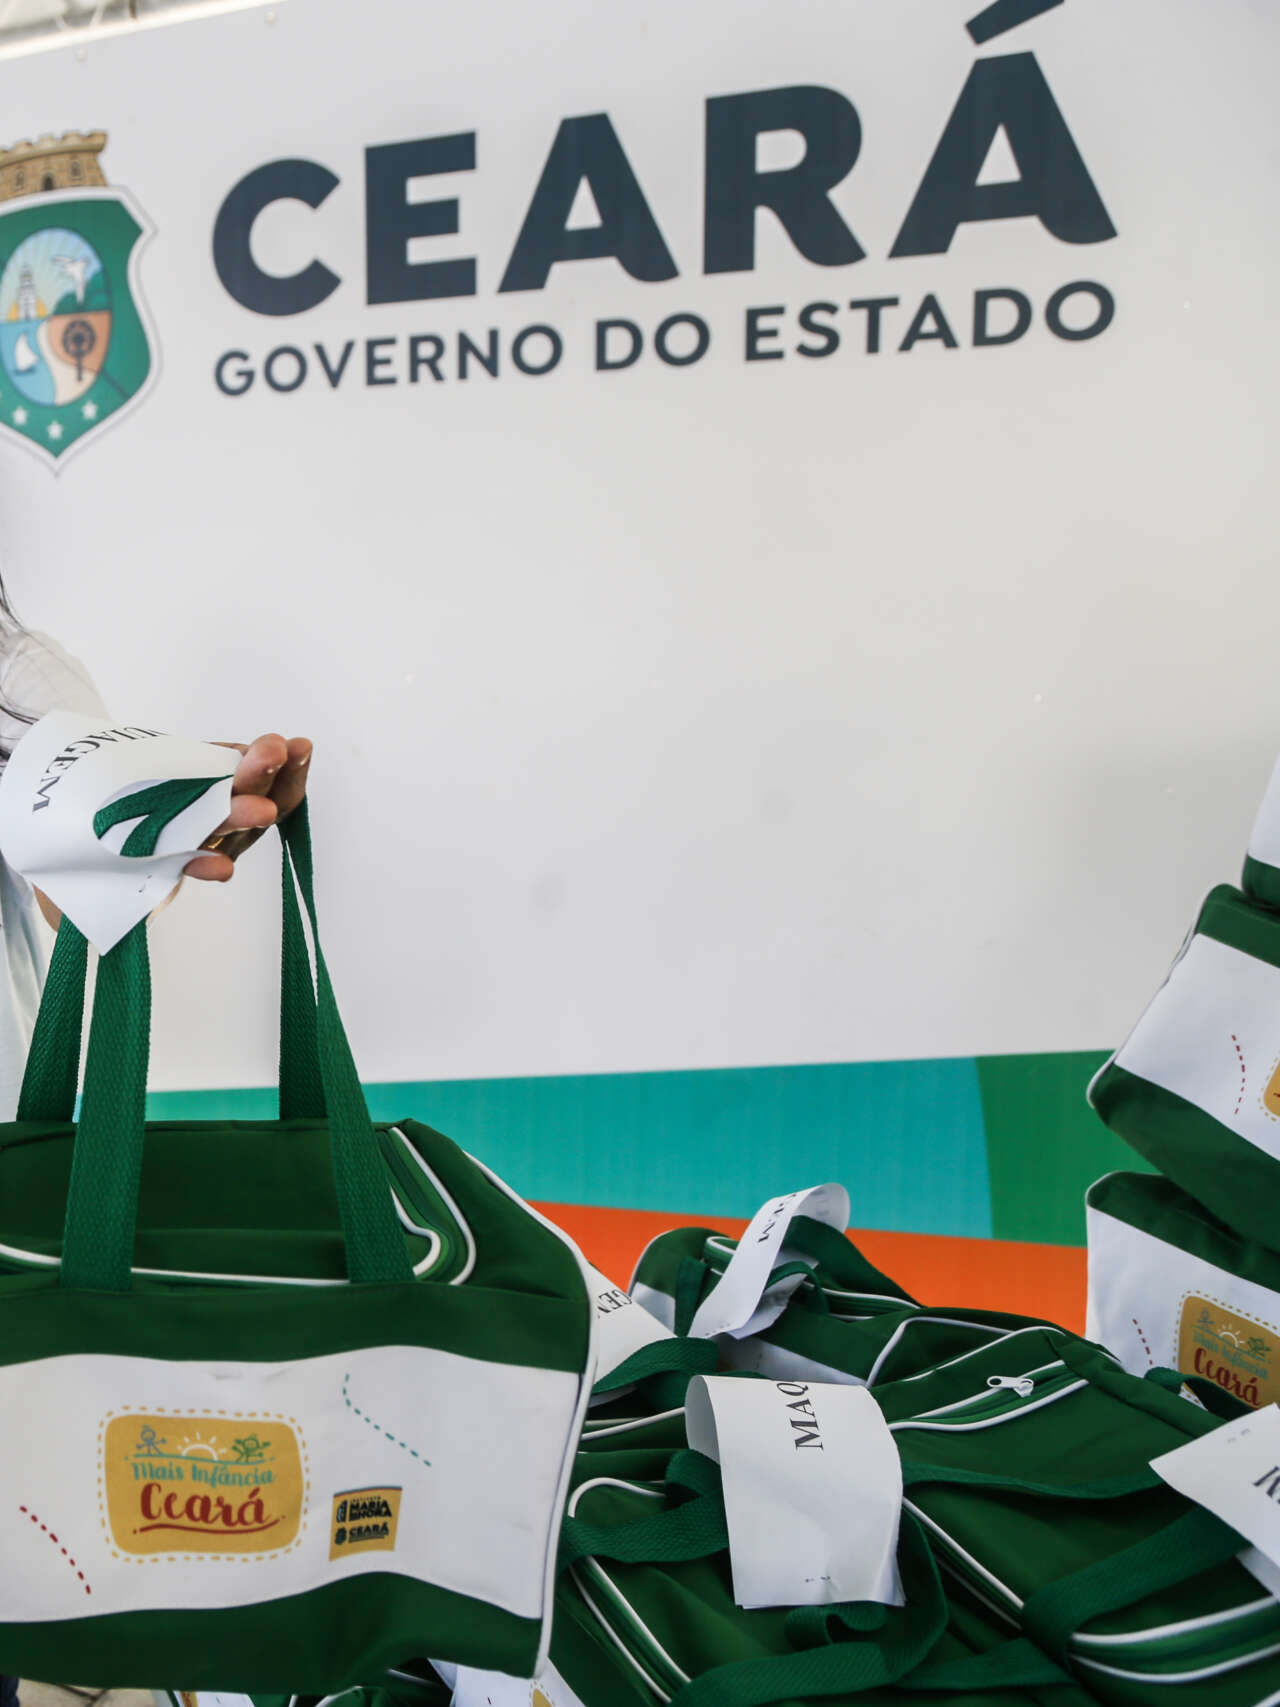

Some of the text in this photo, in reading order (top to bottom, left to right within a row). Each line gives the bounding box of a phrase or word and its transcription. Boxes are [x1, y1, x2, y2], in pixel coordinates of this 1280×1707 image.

[212, 0, 1118, 317] CEARÁ
[214, 280, 1116, 397] GOVERNO DO ESTADO
[1194, 1346, 1262, 1406] Ceará
[776, 1382, 824, 1452] MAQ
[131, 1461, 277, 1489] Mais Infância
[140, 1482, 273, 1528] Ceará
[349, 1521, 390, 1538] CEARÁ
